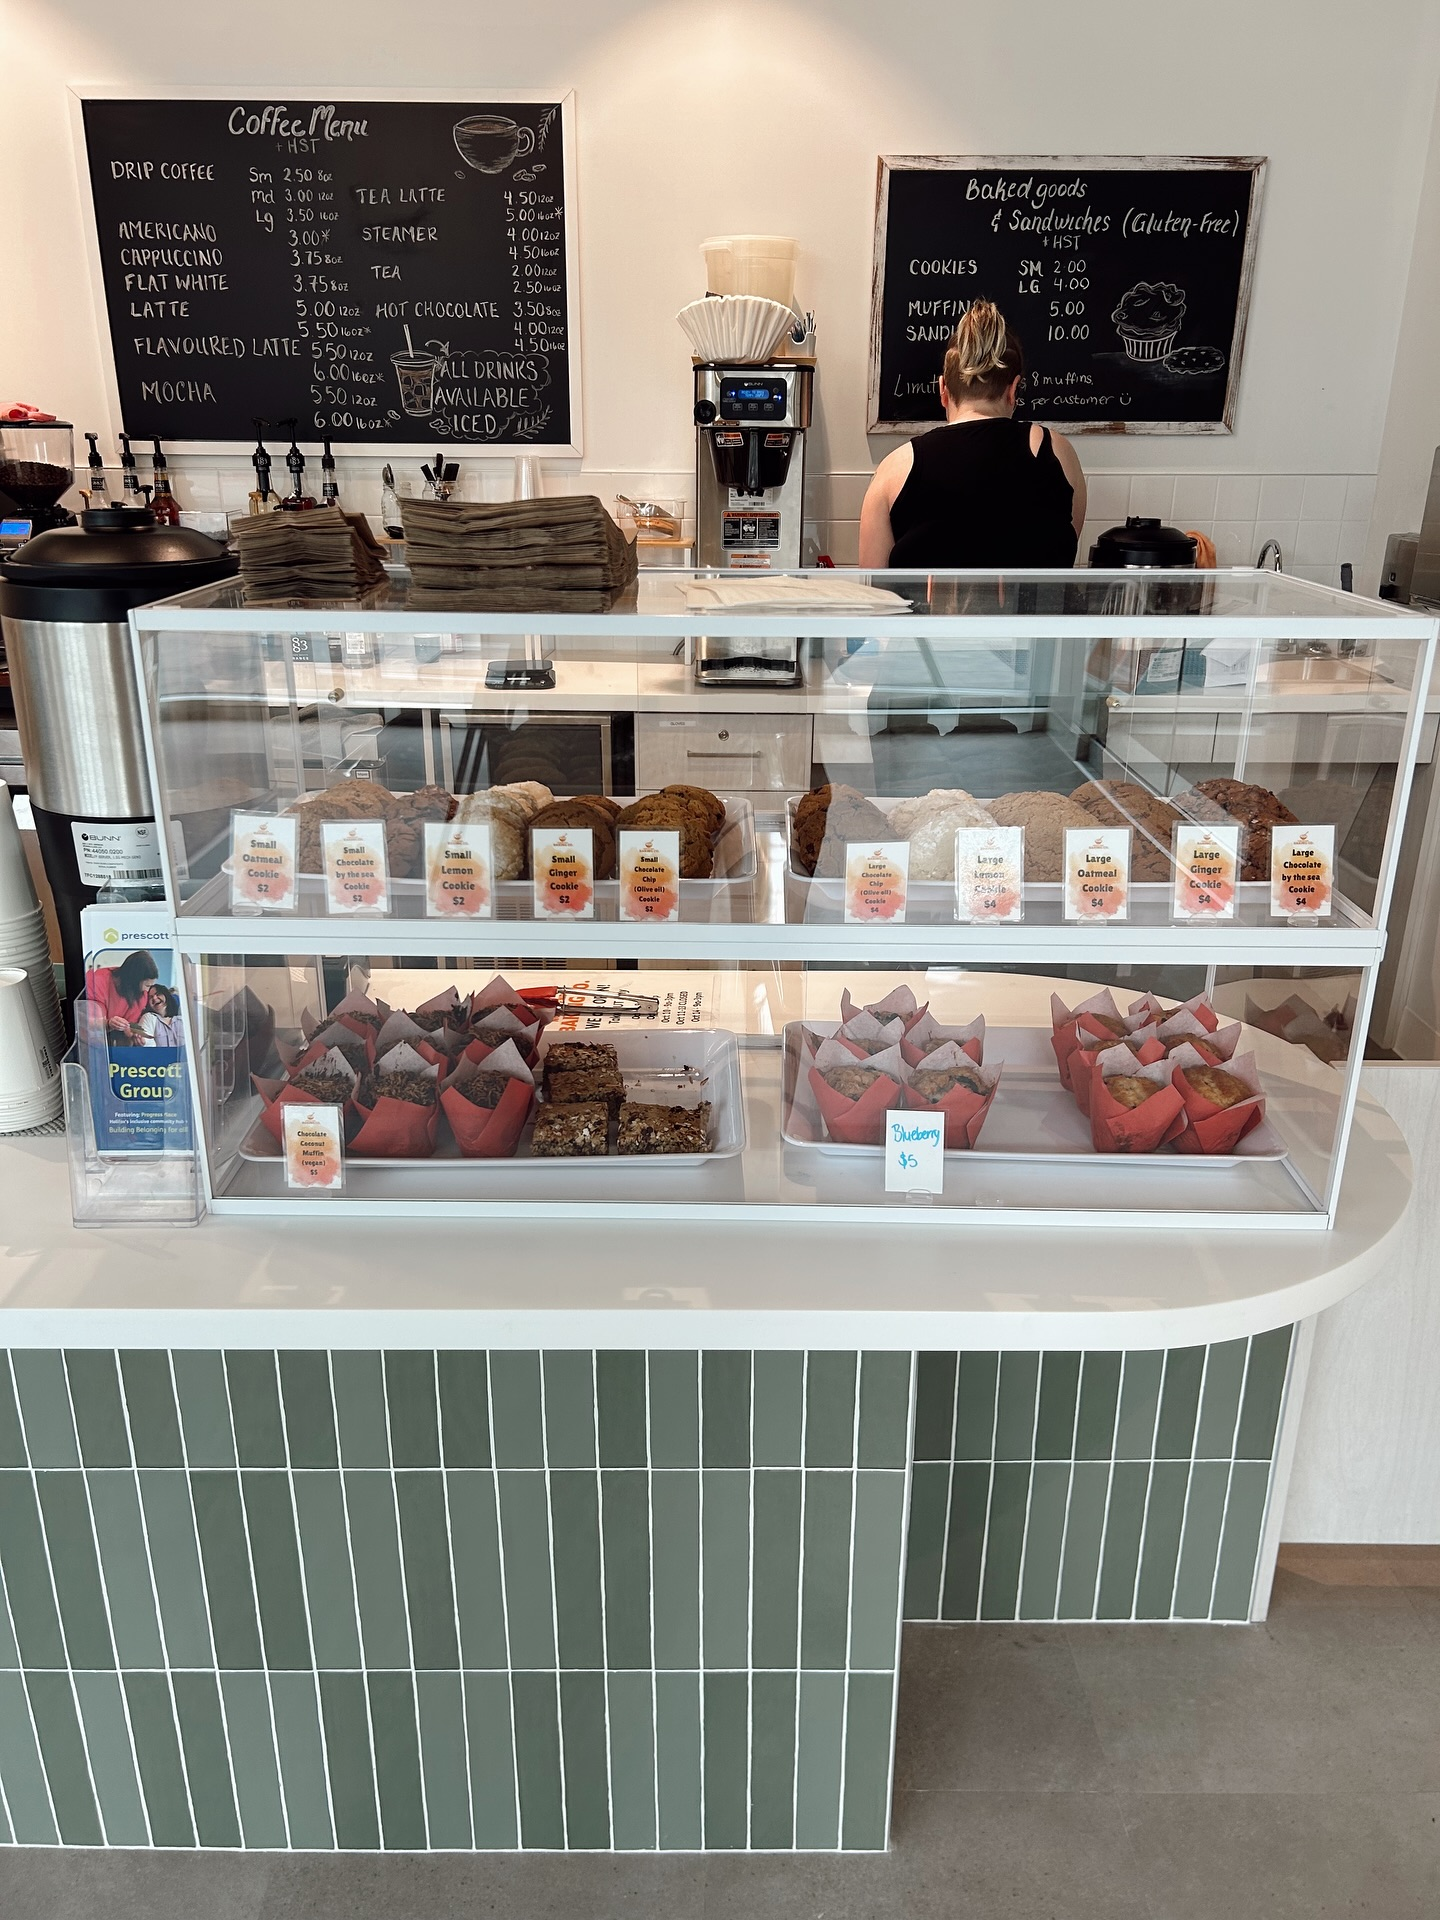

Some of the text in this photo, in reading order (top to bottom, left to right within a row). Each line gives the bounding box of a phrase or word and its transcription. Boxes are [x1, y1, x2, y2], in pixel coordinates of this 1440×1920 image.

[228, 104, 369, 142] Coffee Menu
[288, 138, 320, 154] HST
[111, 160, 215, 181] DRIP COFFEE
[283, 167, 313, 183] 2.50
[284, 189, 314, 203] 3.00
[356, 187, 446, 205] TEA LATTE
[503, 190, 537, 206] 4.50
[966, 176, 1088, 209] Baked goods
[286, 208, 315, 222] 3.50
[505, 207, 536, 223] 5.00
[990, 208, 1002, 233] &
[1008, 205, 1111, 235] Sandwiches
[119, 220, 217, 243] AMERICANO
[362, 225, 539, 243] STEAMER 4.00
[1053, 234, 1082, 251] HST
[120, 248, 223, 267] CAPPUCCINO
[290, 249, 323, 267] 3.75
[508, 245, 540, 260] 4.50
[370, 263, 542, 281] TEA 2.00
[909, 258, 1087, 277] COOKIES SM 2.00
[124, 273, 168, 292] FLAT
[174, 273, 229, 291] WHITE
[292, 273, 329, 293] 3.75
[512, 280, 543, 294] 2.50
[1018, 277, 1090, 294] LG 4.00
[130, 300, 190, 319] LATTE
[296, 299, 336, 317] 5.00
[375, 300, 409, 319] HOT
[414, 300, 500, 319] CHOCOLATE
[512, 300, 545, 318] 3.50
[1049, 300, 1086, 318] 5.00
[297, 320, 339, 339] 5.50
[513, 320, 548, 336] 4.00
[1048, 324, 1090, 342] 10.00
[134, 335, 347, 361] FLAVOURED LATTE 5.50
[514, 337, 549, 352] 4.50
[313, 361, 350, 381] 6.00
[474, 359, 539, 381] DRINKS
[1031, 371, 1039, 386] 8
[141, 380, 347, 405] MOCHA 5.50
[434, 387, 530, 408] AVAILABLE
[1031, 397, 1051, 410] per
[1053, 394, 1115, 406] customer
[313, 410, 353, 428] 6.00
[453, 413, 497, 434] ICED
[89, 834, 121, 842] BUNN
[250, 839, 277, 850] Small
[242, 853, 283, 865] Oatmeal
[444, 850, 472, 860] Small
[551, 855, 576, 864] Small
[977, 855, 1004, 866] Large
[1085, 854, 1112, 865] Large
[1193, 850, 1220, 861] Large
[1292, 849, 1314, 858] Large
[441, 865, 474, 875] Lemon
[868, 863, 886, 871] Large
[1190, 865, 1223, 876] Ginger
[1283, 861, 1322, 869] Chocolate
[247, 868, 280, 879] Cookie
[336, 871, 345, 880] by
[549, 869, 578, 879] Ginger
[642, 876, 657, 884] Chip
[1077, 869, 1117, 878] Oatmeal
[1282, 873, 1291, 882] by
[1293, 873, 1306, 881] the
[257, 884, 269, 893] $2
[442, 881, 475, 891] Cookie
[550, 882, 579, 891] Cookie
[869, 880, 884, 888] Chip
[1082, 884, 1114, 893] Cookie
[1189, 880, 1222, 889] Cookie
[1288, 885, 1315, 893] Cookie
[352, 894, 363, 903] $2
[452, 896, 465, 906] $2
[559, 895, 570, 904] $2
[984, 900, 997, 909] $4
[1091, 898, 1103, 907] $4
[1198, 894, 1211, 904] $4
[1296, 897, 1307, 906] $4
[645, 905, 653, 913] $2
[121, 931, 170, 941] prescott
[109, 1063, 182, 1078] Prescott
[120, 1083, 173, 1098] Group
[109, 1126, 135, 1134] Building
[891, 1123, 940, 1147] Blueberry
[898, 1151, 918, 1170] $5
